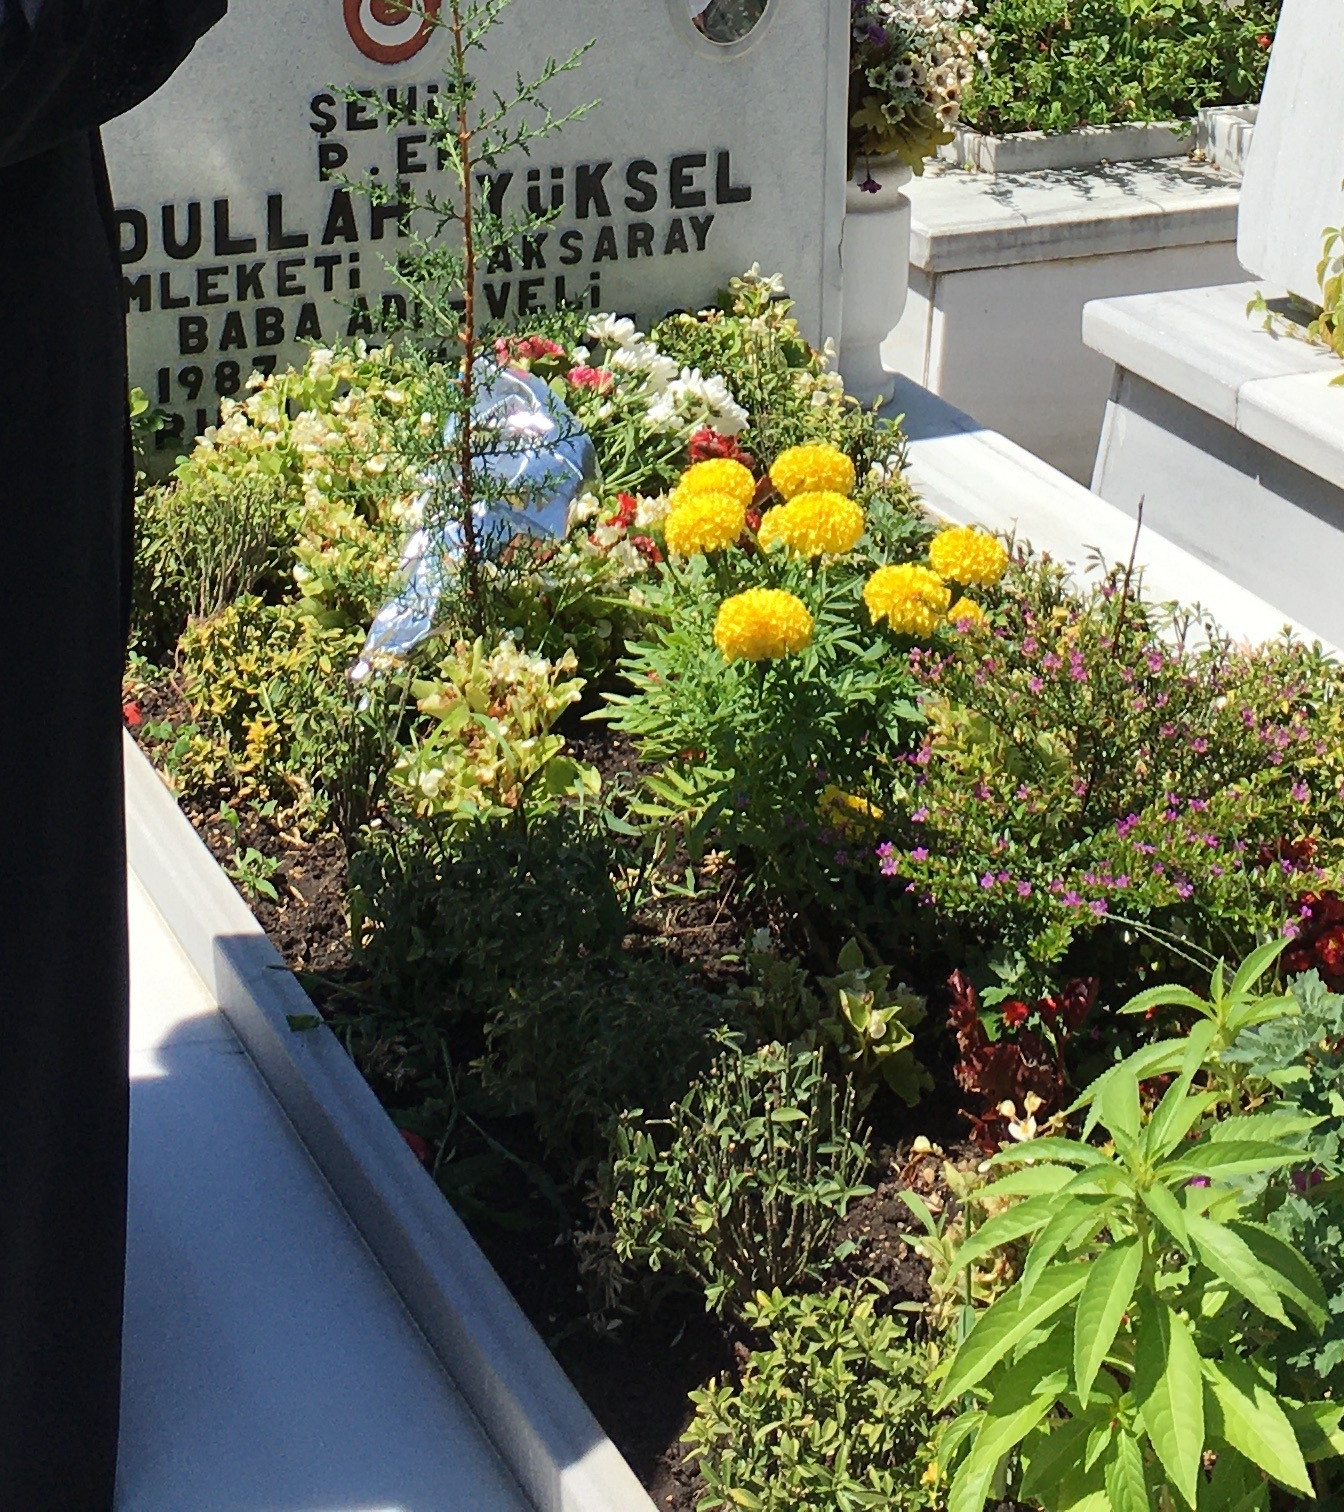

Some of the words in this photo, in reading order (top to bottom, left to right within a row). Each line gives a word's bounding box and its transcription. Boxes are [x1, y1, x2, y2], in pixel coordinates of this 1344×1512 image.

[114, 180, 413, 266] DULLAH
[474, 149, 753, 220] YÜKSEL
[123, 251, 362, 315] MLEKETİ
[485, 214, 716, 275] AKSARAY
[179, 301, 324, 356] BABA
